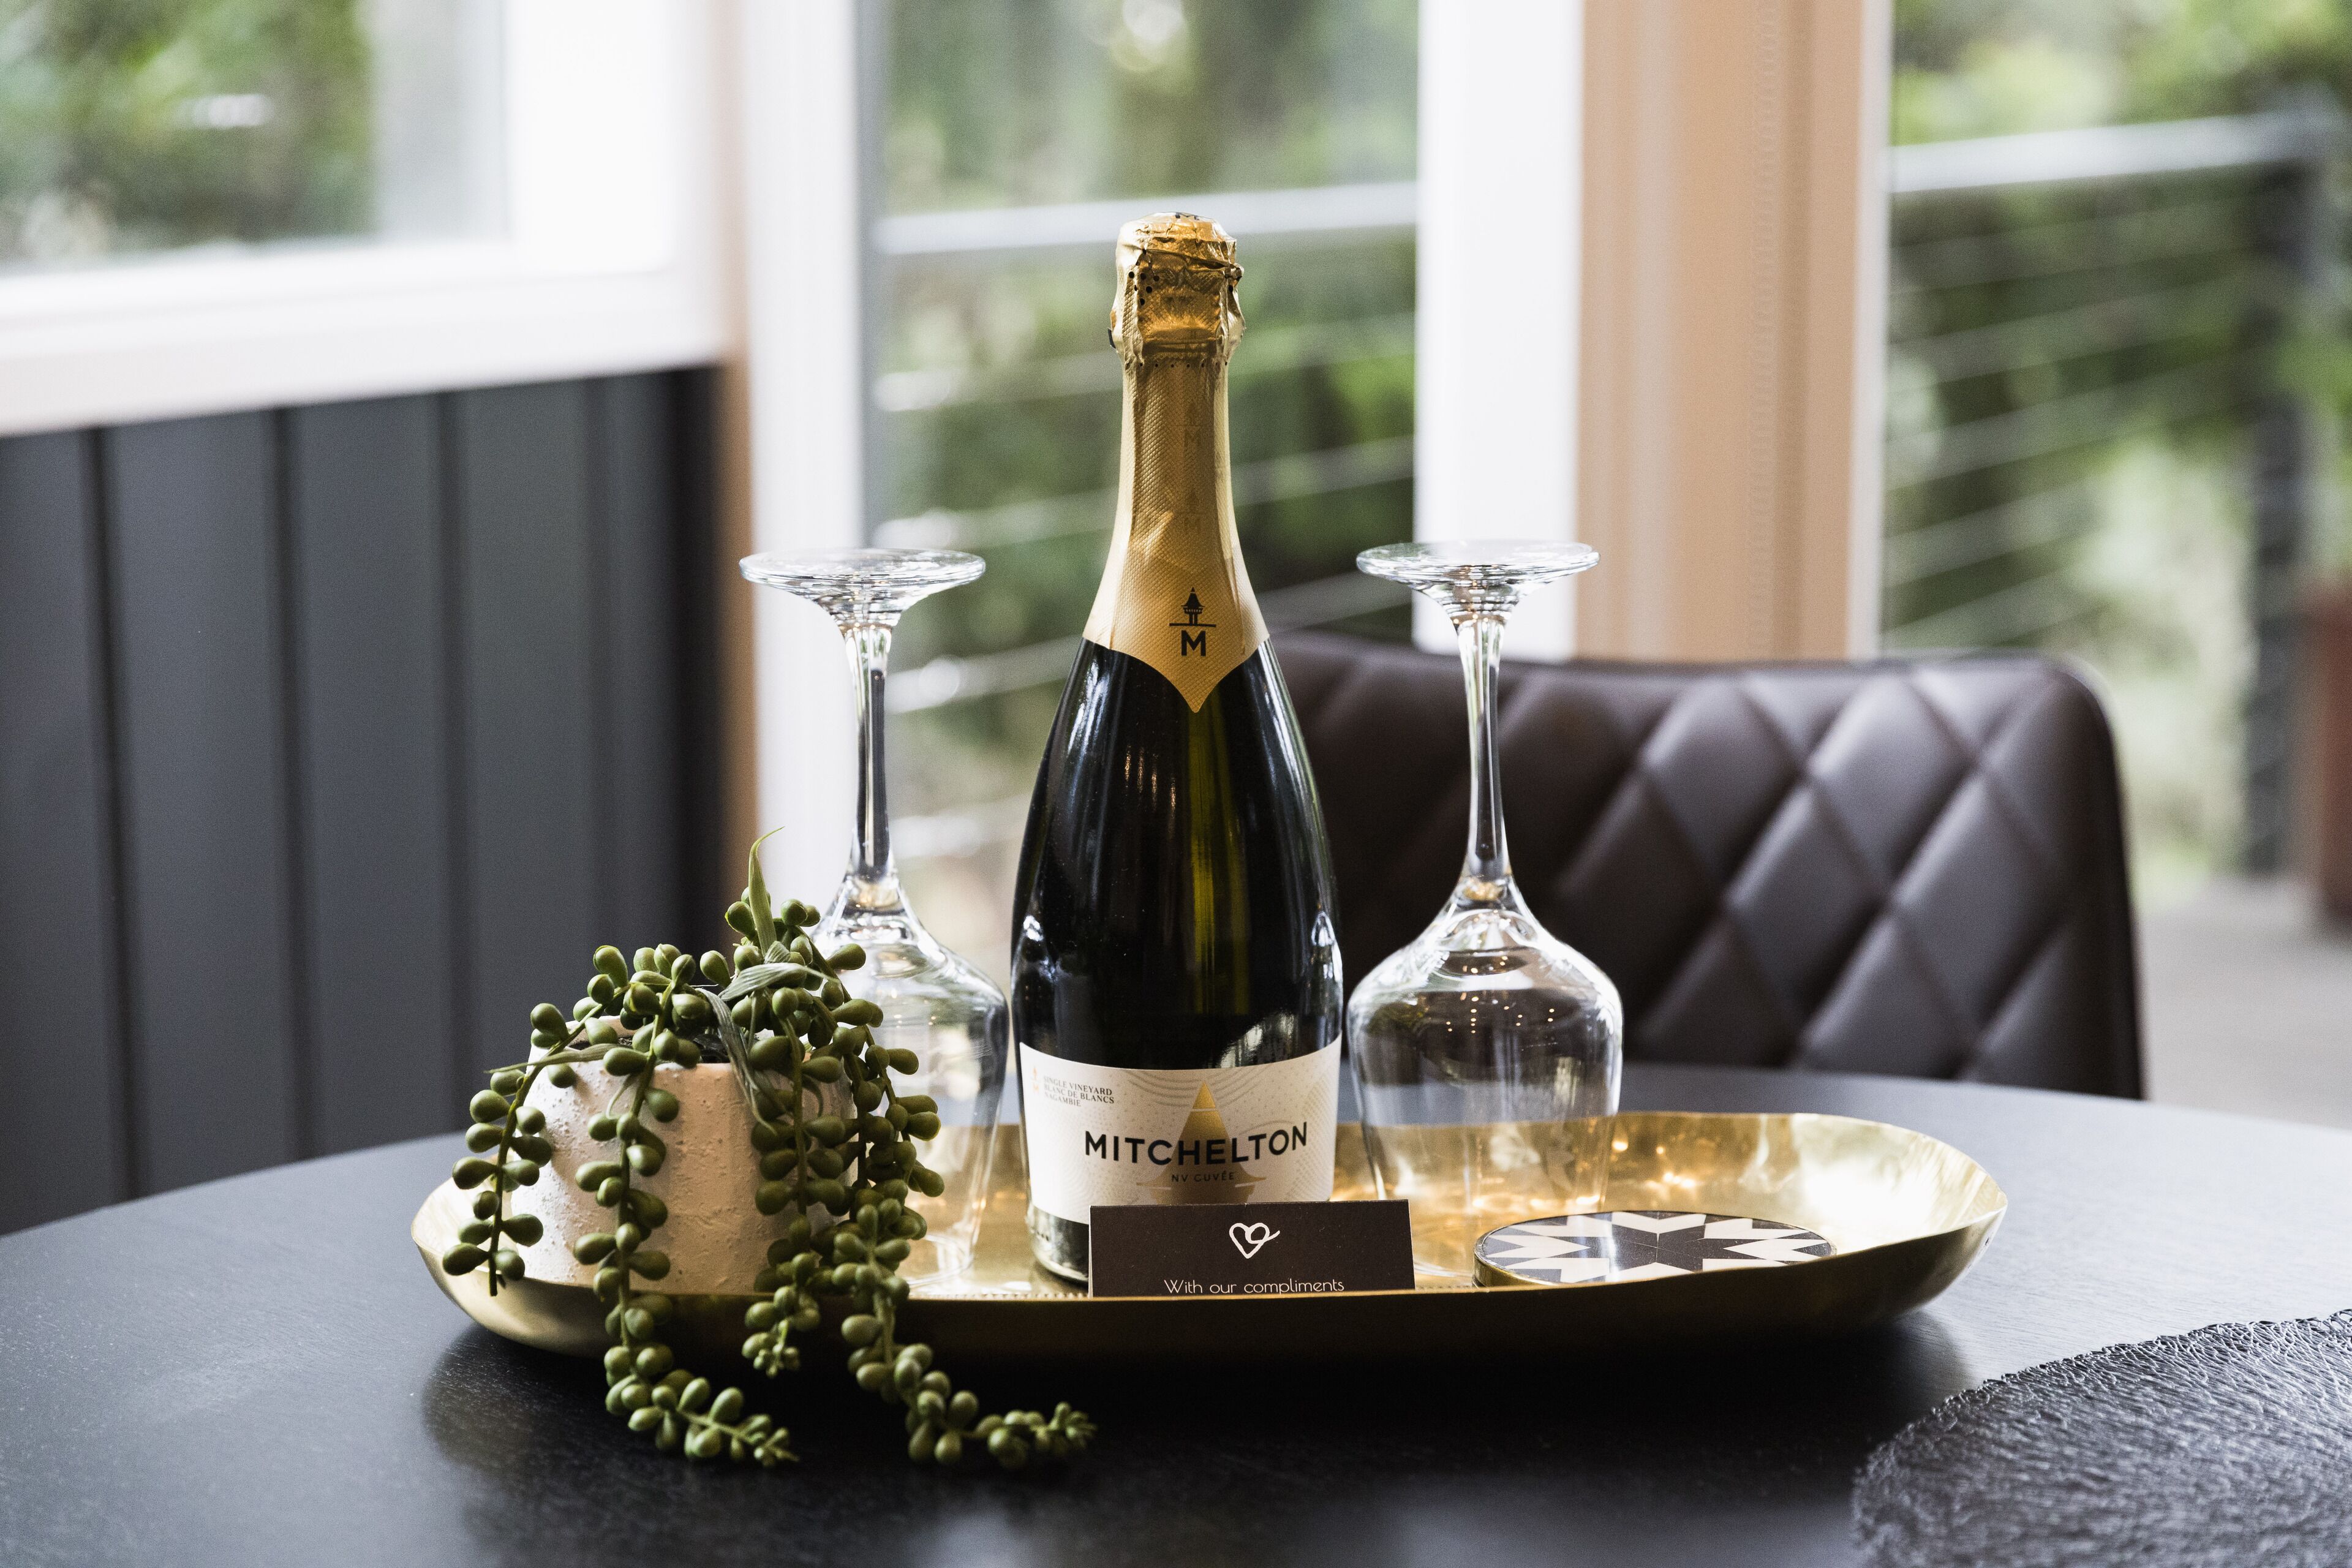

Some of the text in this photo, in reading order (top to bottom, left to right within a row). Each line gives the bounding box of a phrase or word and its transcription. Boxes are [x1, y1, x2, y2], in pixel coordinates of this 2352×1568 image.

[1181, 630, 1207, 657] M
[1044, 1076, 1112, 1096] SINGLE VINEYARD
[1044, 1083, 1114, 1104] BLANC DE BLANCS
[1044, 1091, 1082, 1107] NAGAMBIE
[1085, 1121, 1307, 1166] MITCHELTON
[1171, 1170, 1235, 1183] NV CUVÉE
[1164, 1278, 1344, 1295] With our compliments
